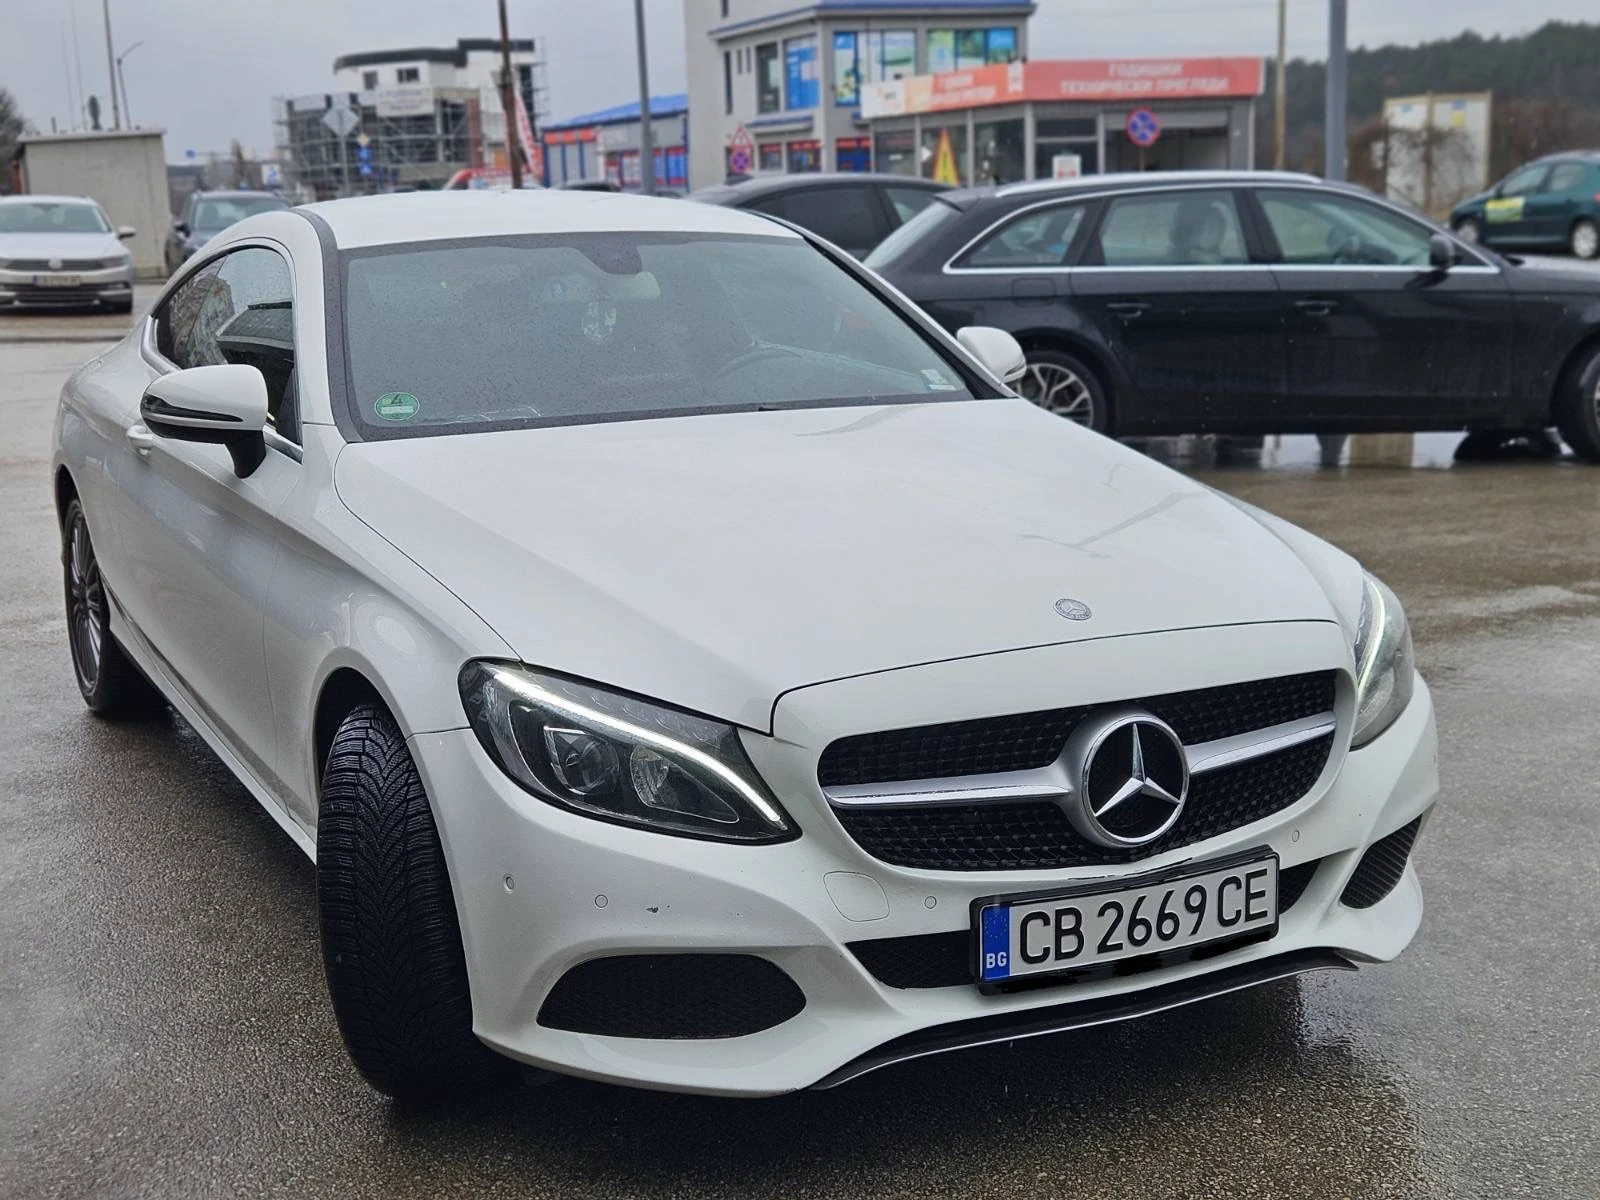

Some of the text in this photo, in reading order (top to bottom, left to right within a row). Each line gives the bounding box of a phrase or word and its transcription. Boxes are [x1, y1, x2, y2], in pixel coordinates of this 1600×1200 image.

[1020, 868, 1267, 965] CB 2669 CE
[986, 951, 1007, 969] BG
